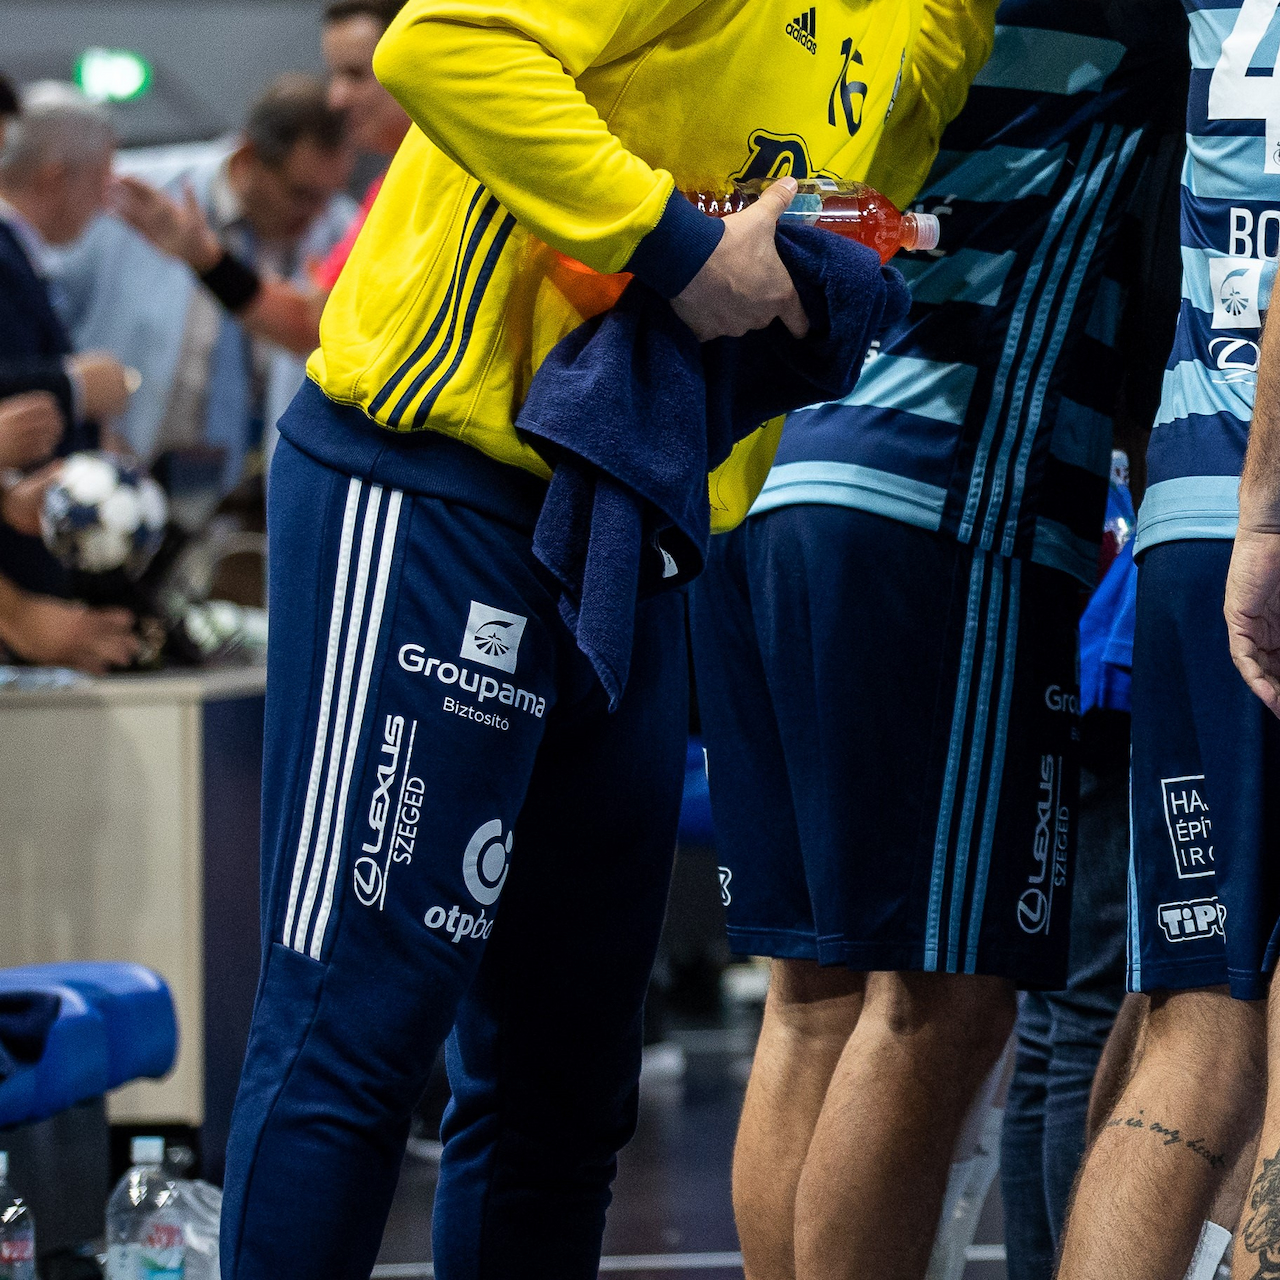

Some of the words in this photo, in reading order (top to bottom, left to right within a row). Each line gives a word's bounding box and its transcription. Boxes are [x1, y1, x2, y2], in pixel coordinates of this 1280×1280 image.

[785, 21, 818, 56] adidas
[828, 37, 868, 137] 16
[398, 643, 546, 718] Groupama
[362, 714, 405, 854] LEXUS
[392, 776, 425, 865] SZEGED
[1028, 753, 1053, 885] LEXUS
[1053, 806, 1069, 888] SZEGED
